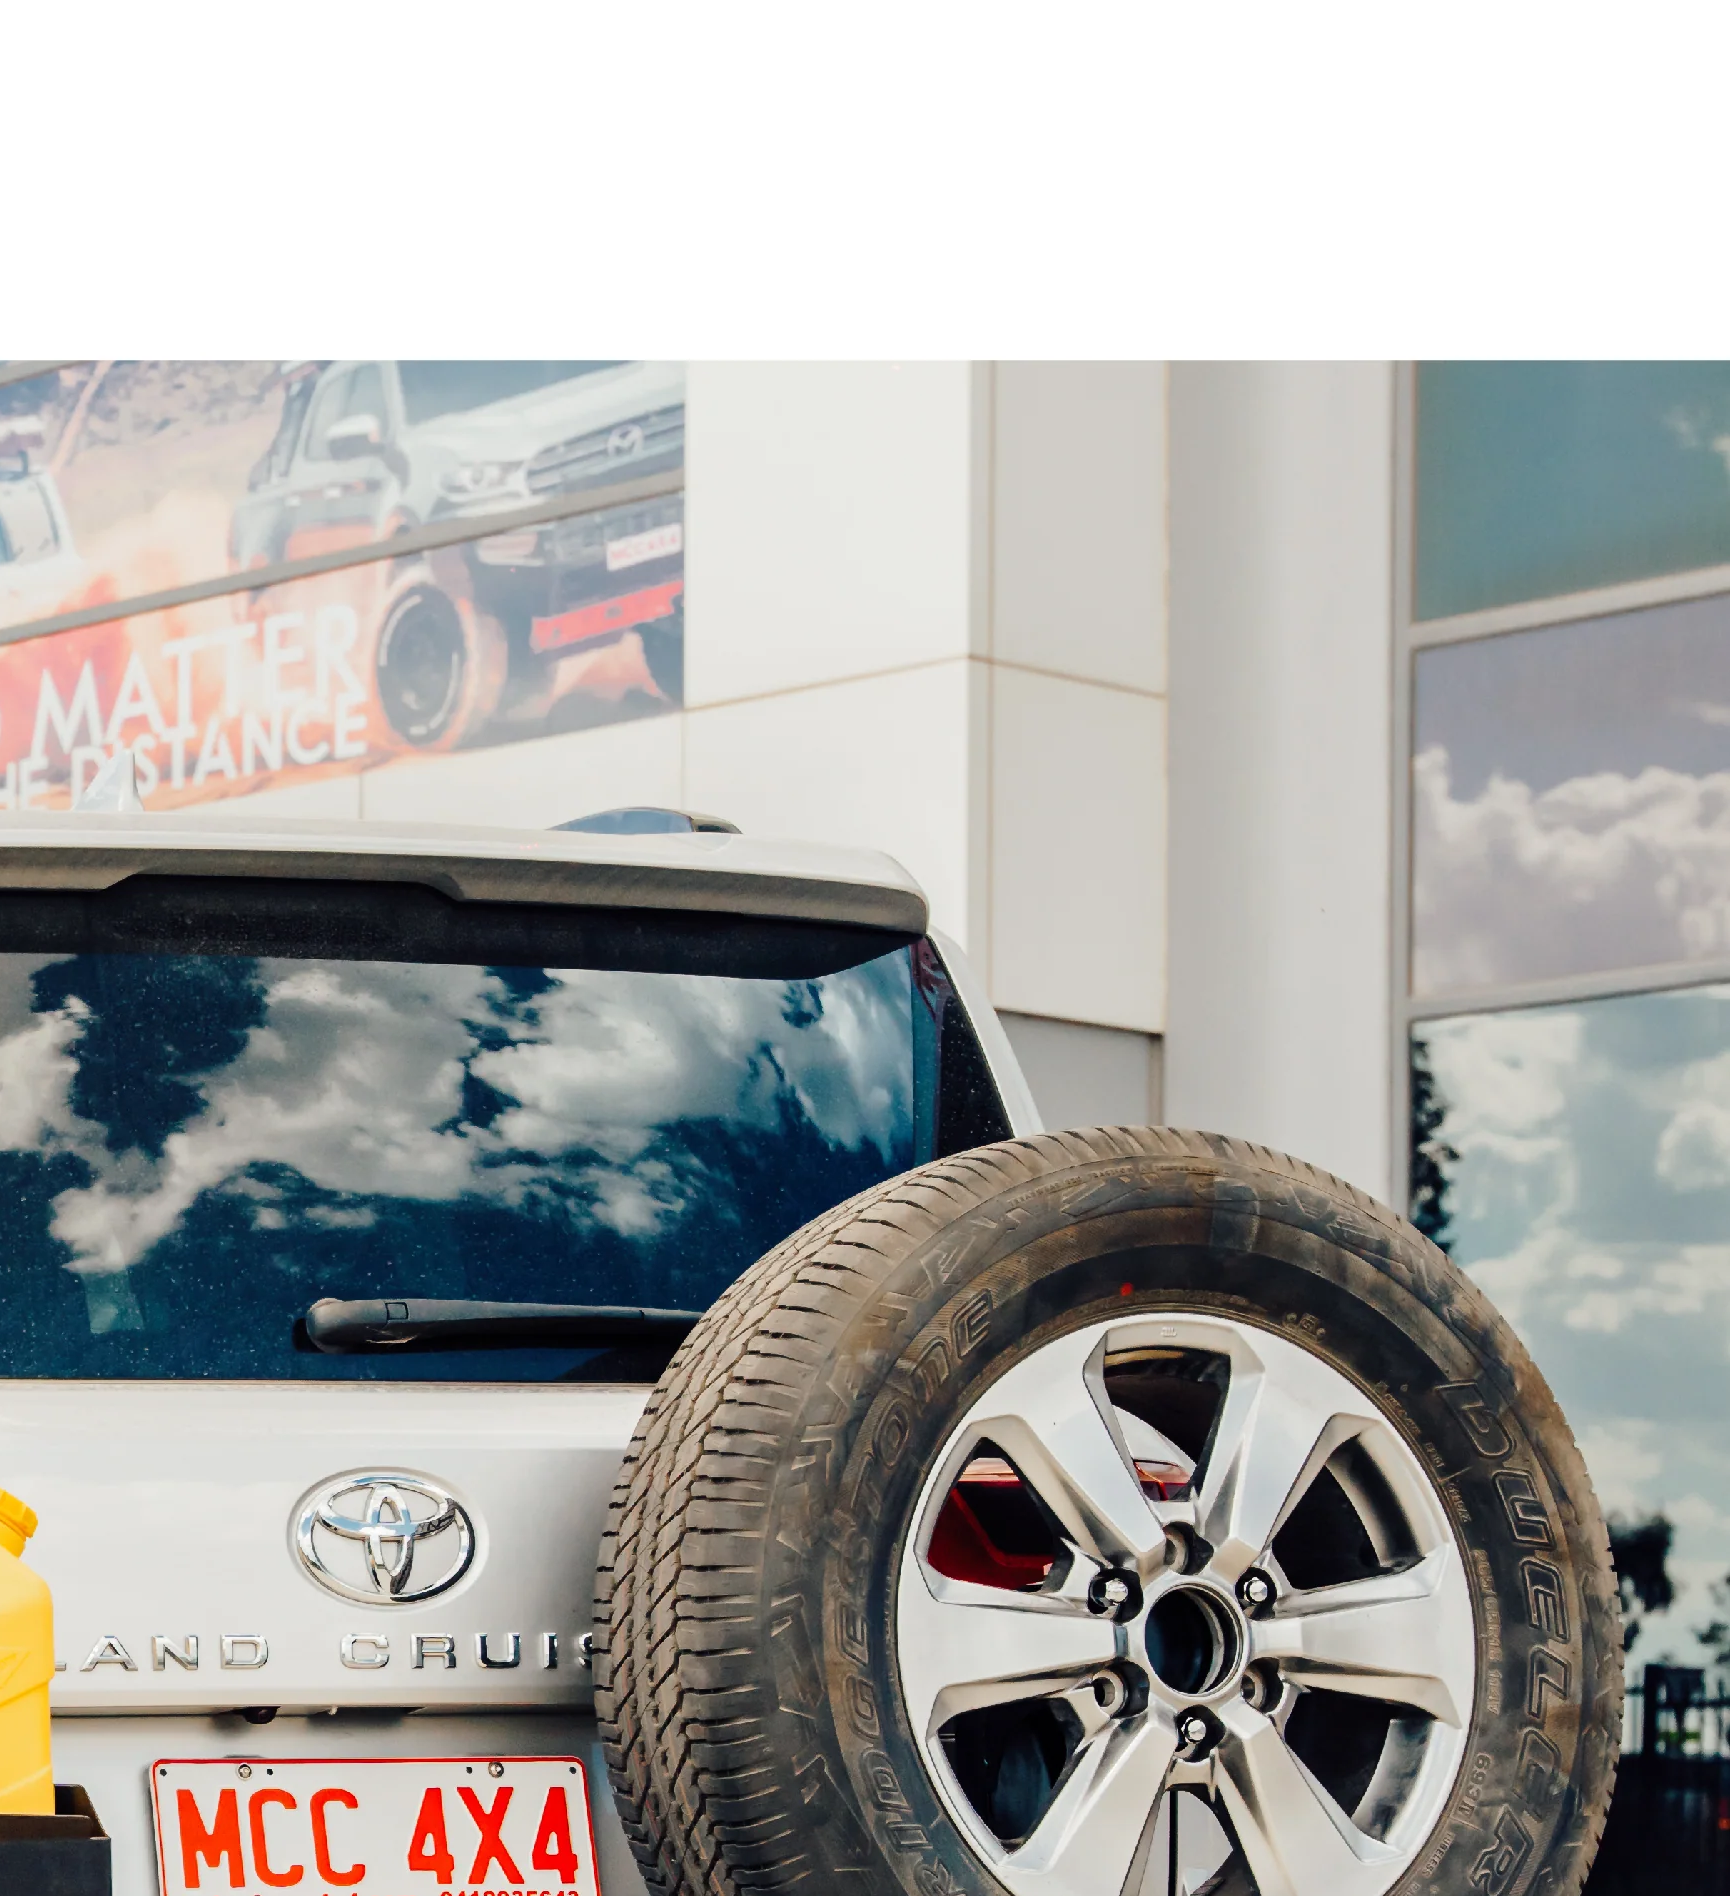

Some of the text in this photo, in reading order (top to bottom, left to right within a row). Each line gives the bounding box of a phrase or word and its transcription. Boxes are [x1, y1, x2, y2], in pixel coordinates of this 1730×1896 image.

[29, 603, 367, 762] MATTER
[71, 697, 368, 806] DSTANCE
[55, 1634, 270, 1673] AND
[176, 1786, 579, 1889] MCC 4X4
